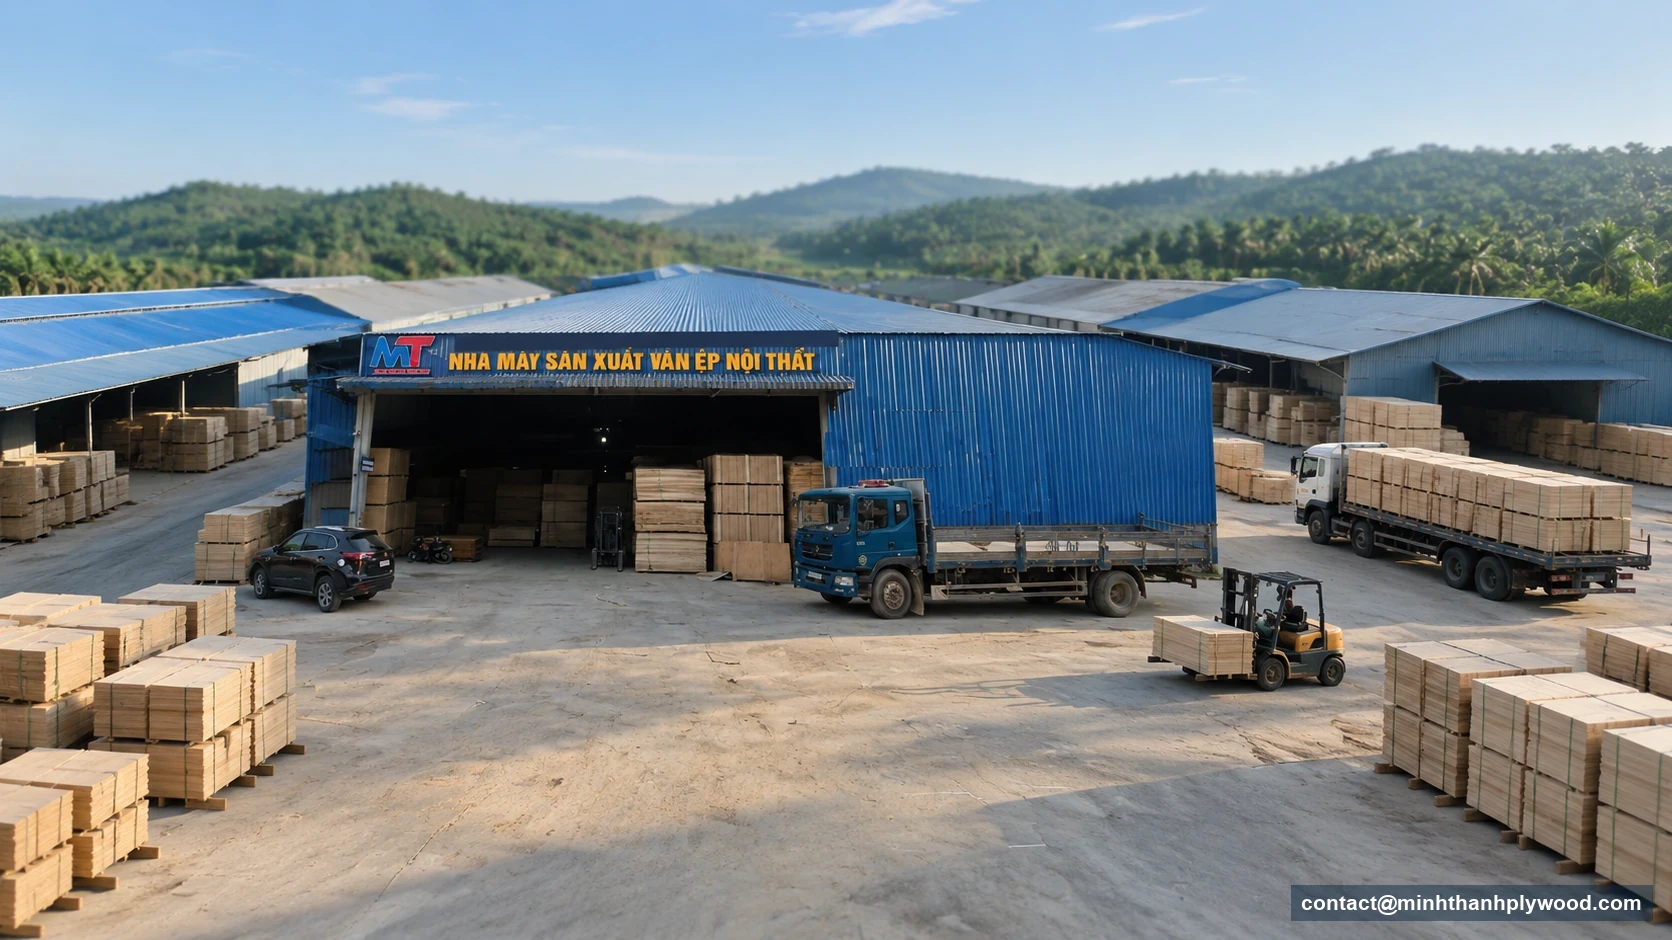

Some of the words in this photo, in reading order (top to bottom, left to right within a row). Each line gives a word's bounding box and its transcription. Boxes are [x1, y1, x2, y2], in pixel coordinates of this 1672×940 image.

[369, 336, 436, 367] MT
[593, 346, 644, 371] XUẤT
[726, 348, 761, 374] NỘI
[765, 347, 815, 371] THẤT
